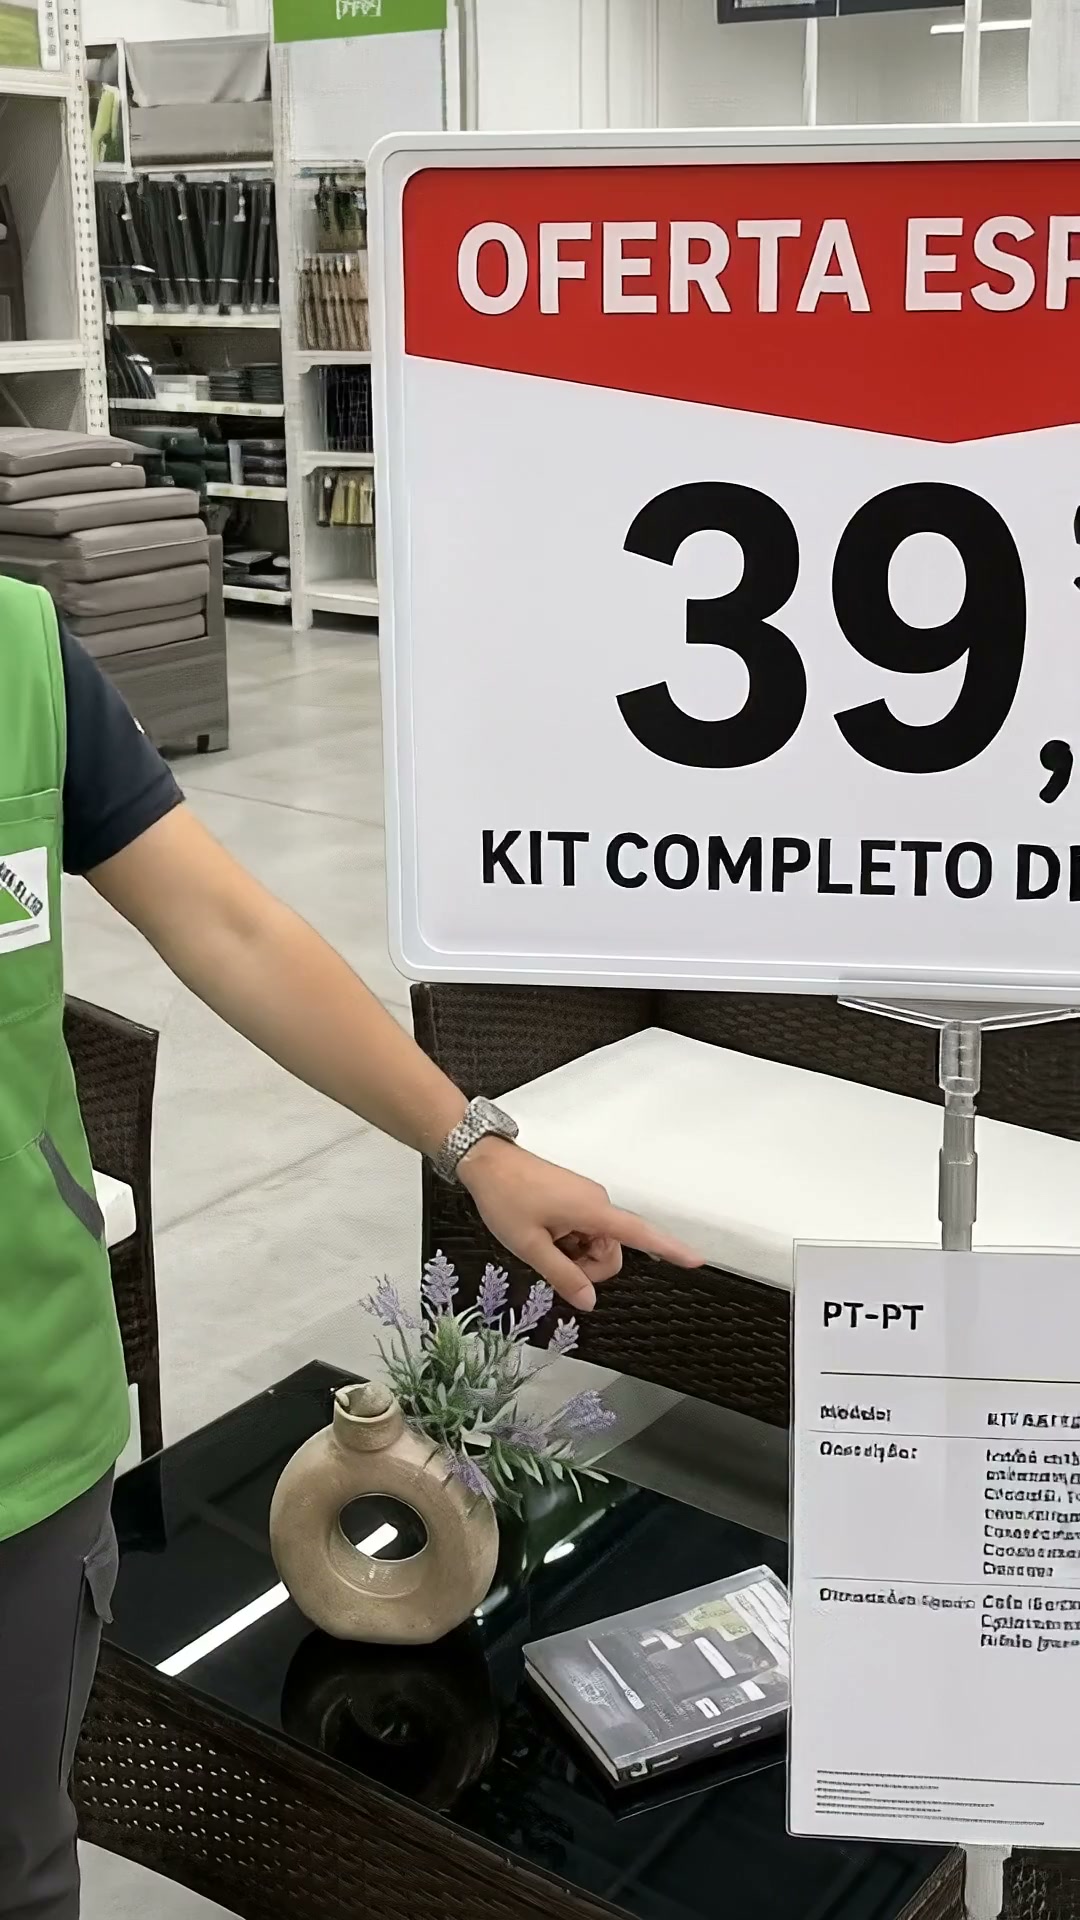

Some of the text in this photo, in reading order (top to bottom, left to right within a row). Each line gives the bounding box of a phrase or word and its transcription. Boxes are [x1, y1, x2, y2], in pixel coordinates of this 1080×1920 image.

[457, 219, 871, 315] OFERTA
[616, 482, 1080, 803] 39,
[483, 830, 590, 886] KIT
[607, 833, 993, 899] COMPLETO
[823, 1301, 924, 1331] PT-PT
